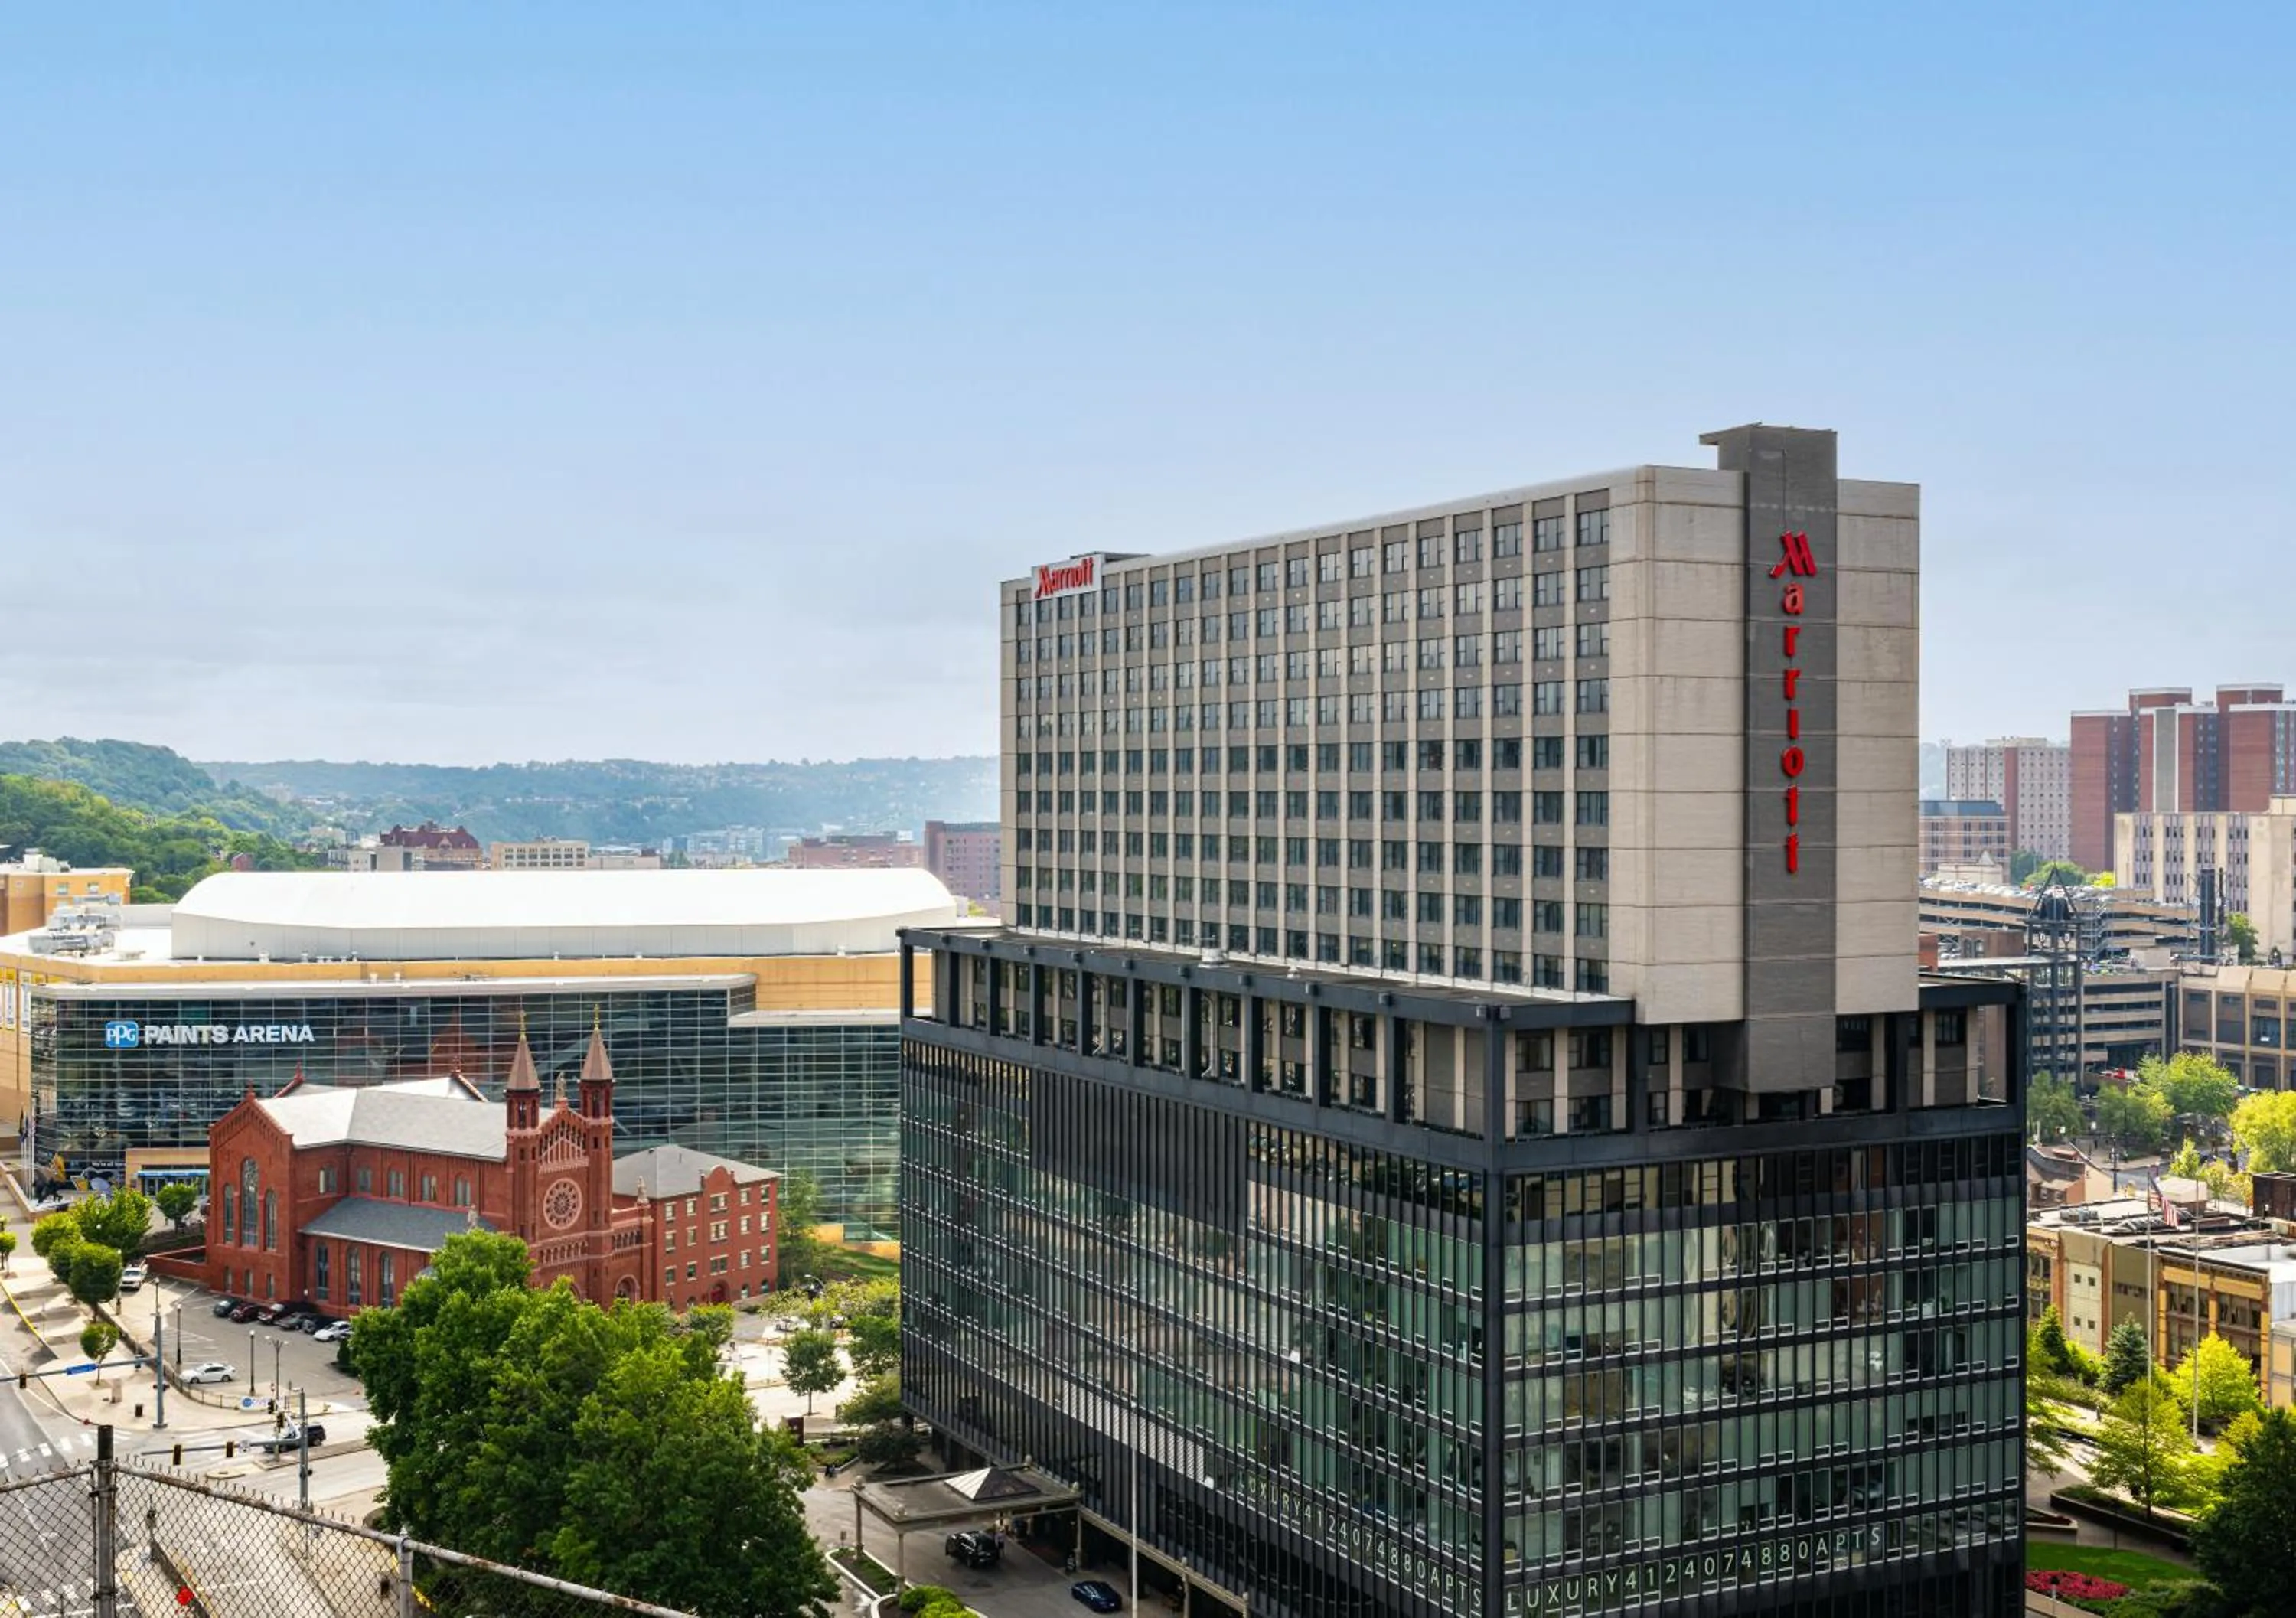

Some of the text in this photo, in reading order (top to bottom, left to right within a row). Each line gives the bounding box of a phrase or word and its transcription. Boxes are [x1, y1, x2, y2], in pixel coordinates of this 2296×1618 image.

[1035, 556, 1094, 599] Marriott
[1769, 530, 1817, 874] Marriott
[106, 1024, 315, 1045] PPG PAINTS ARENA
